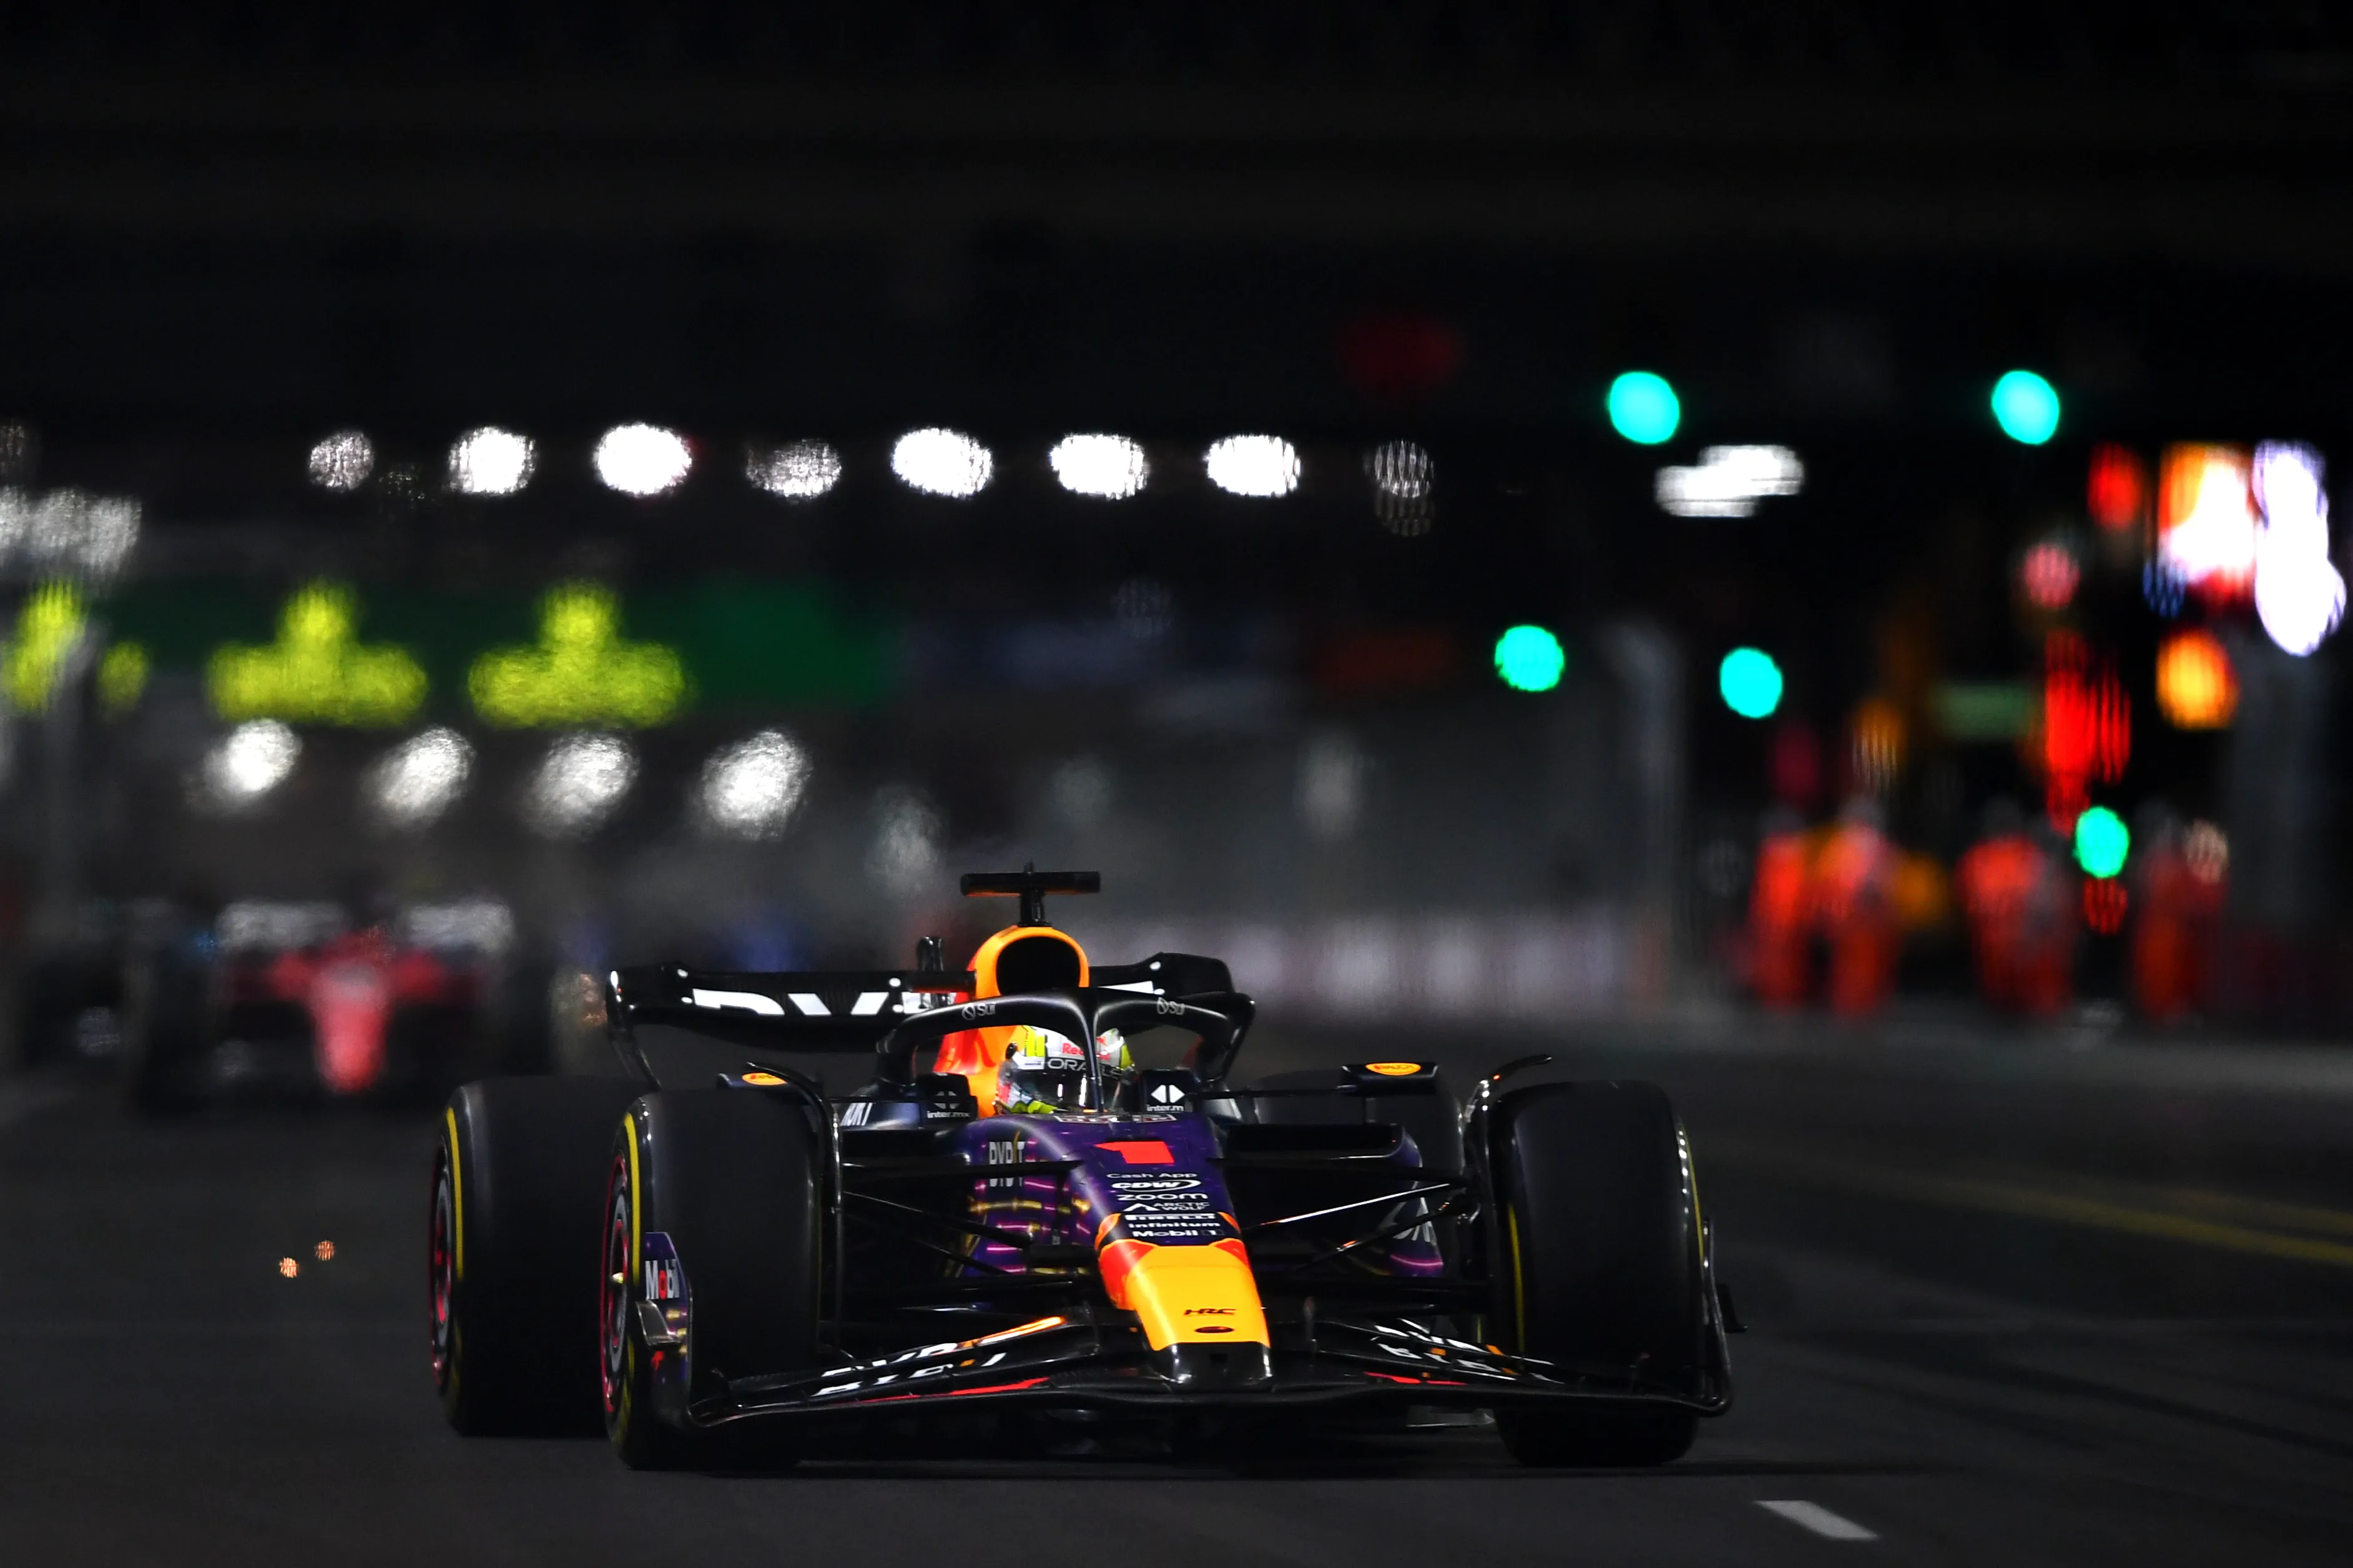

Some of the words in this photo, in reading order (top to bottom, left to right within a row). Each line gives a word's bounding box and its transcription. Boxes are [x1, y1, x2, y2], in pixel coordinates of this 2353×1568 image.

[1048, 1058, 1123, 1080] ORALE
[989, 1141, 1025, 1187] BYBT
[1094, 1141, 1175, 1164] 1
